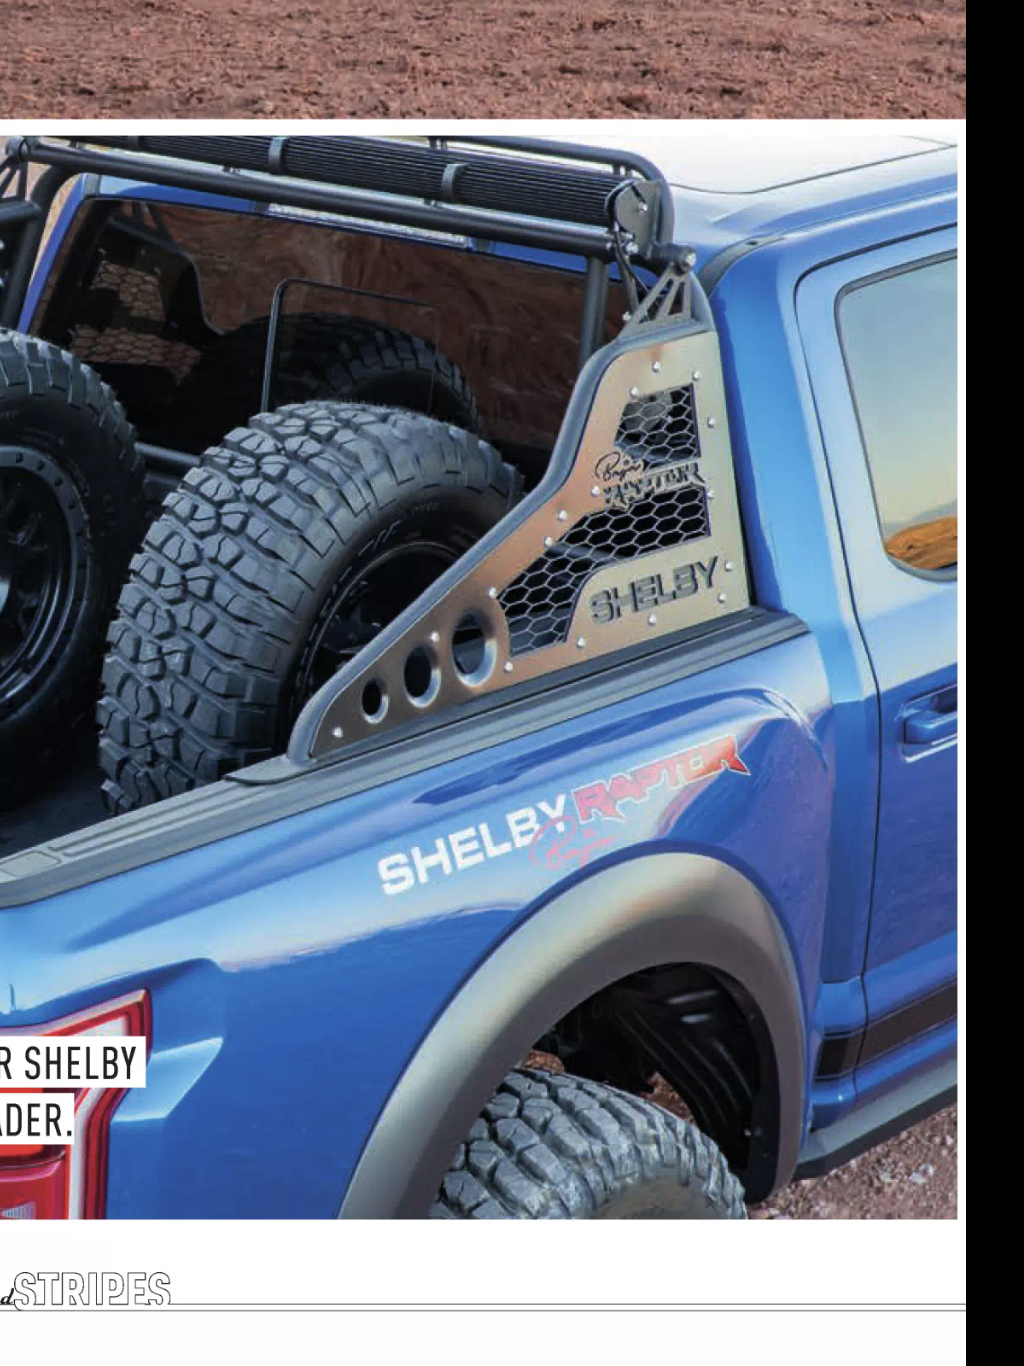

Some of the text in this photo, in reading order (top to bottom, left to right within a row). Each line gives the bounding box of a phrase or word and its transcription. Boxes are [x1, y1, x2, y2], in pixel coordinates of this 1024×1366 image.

[588, 554, 719, 625] SHELBY
[377, 733, 751, 897] SHELBY RAPTOR
[14, 1271, 171, 1307] STRIPES
